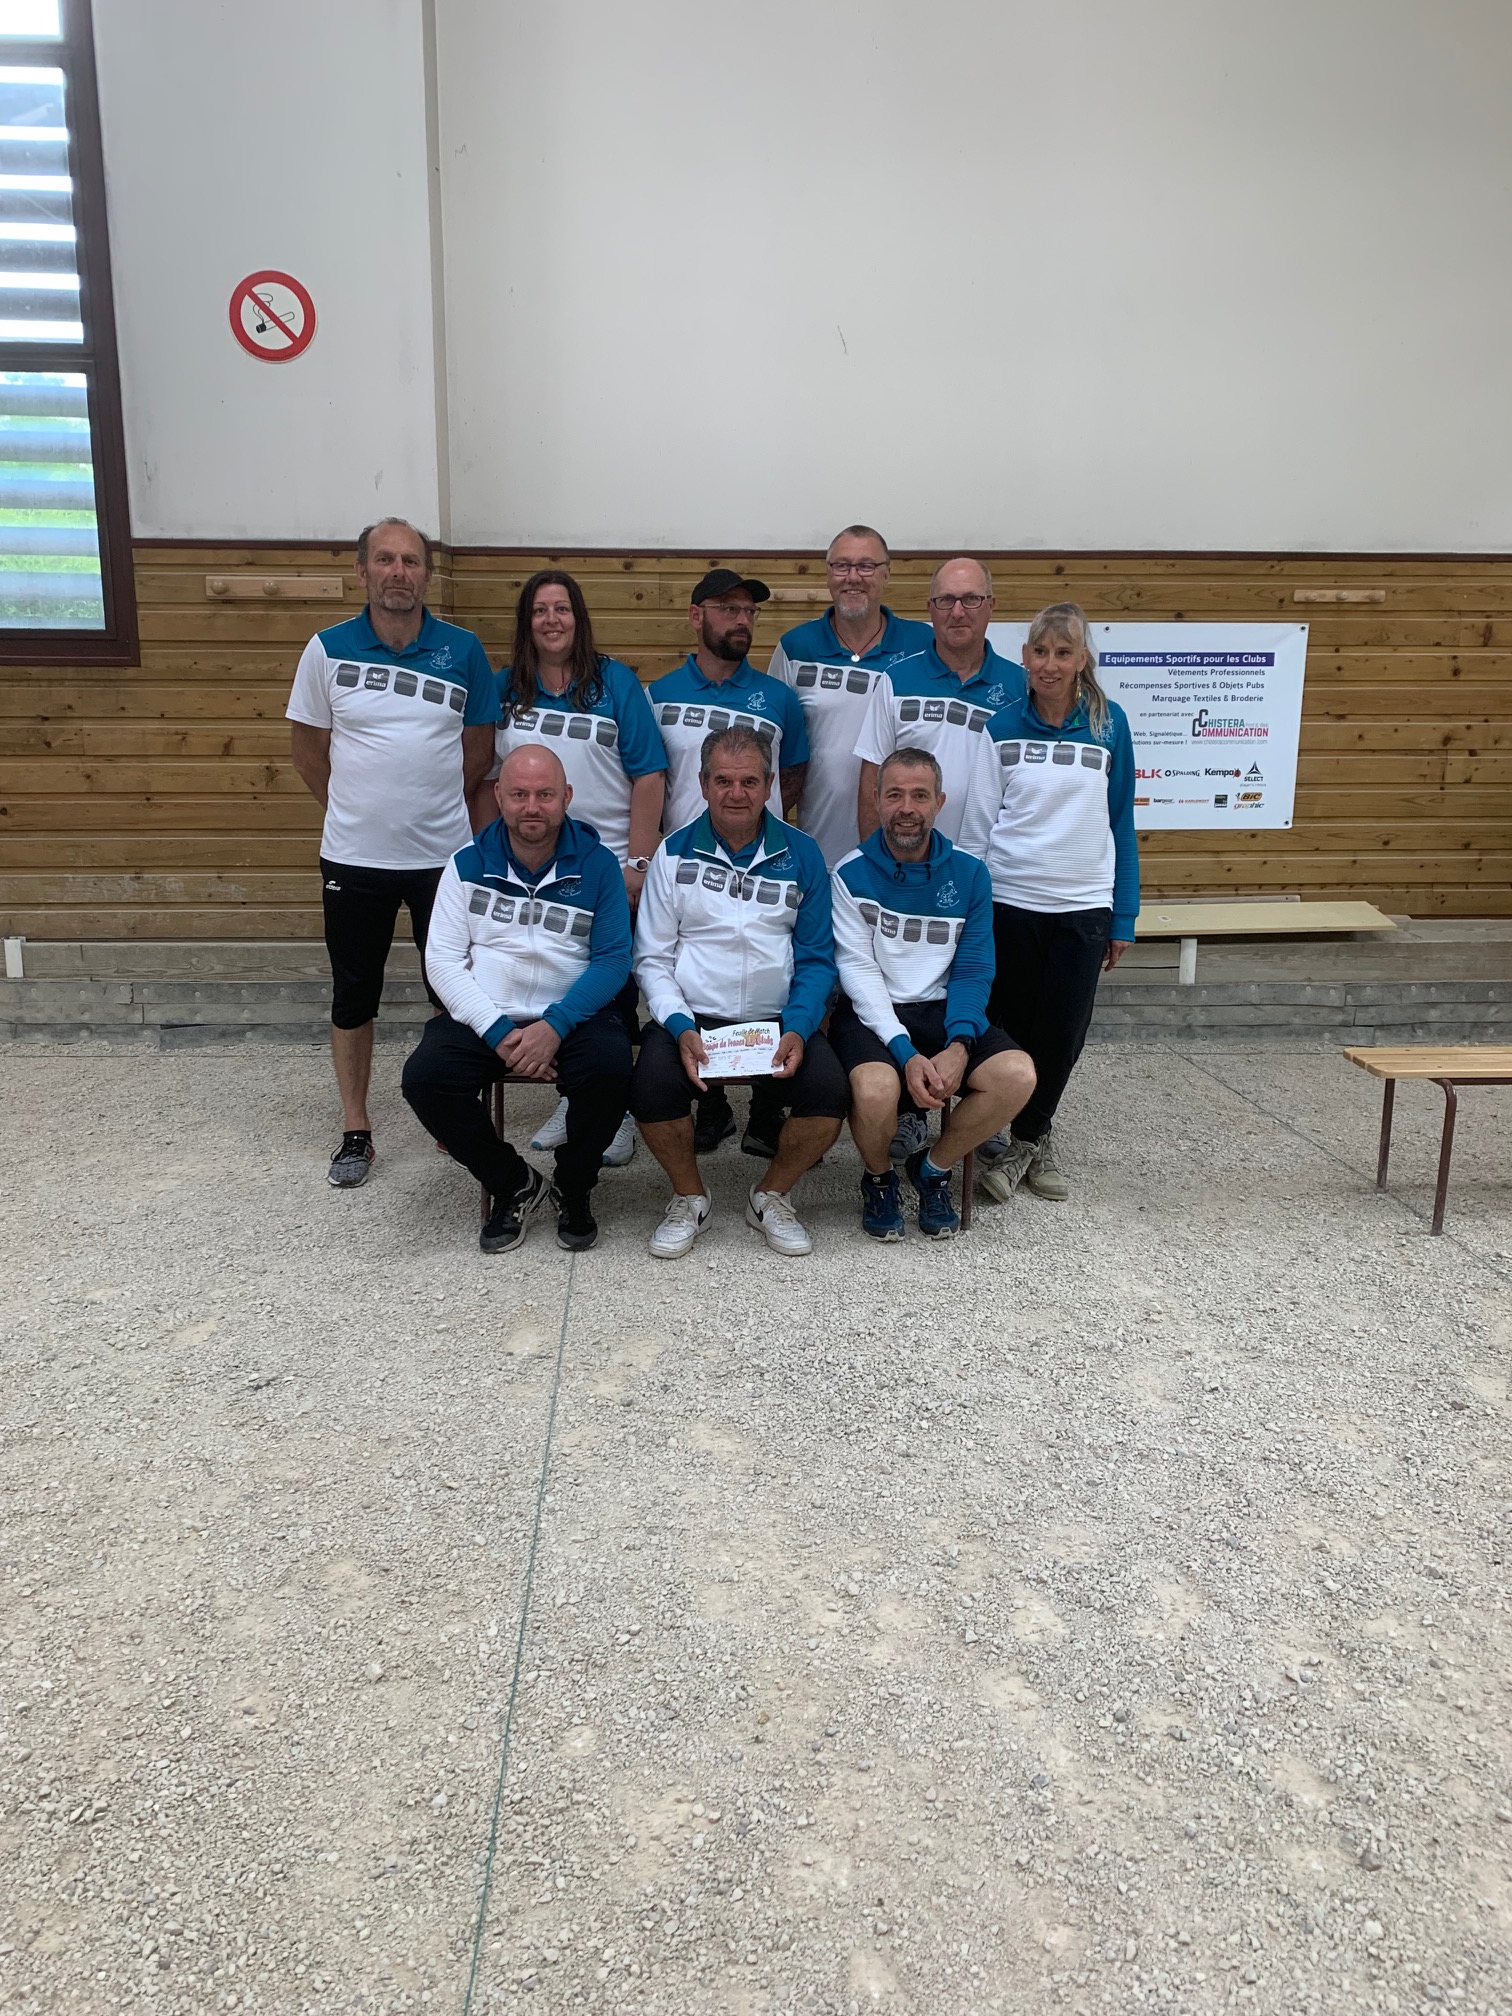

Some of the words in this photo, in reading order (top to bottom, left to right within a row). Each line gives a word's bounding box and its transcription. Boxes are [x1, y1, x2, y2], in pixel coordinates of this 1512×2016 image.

[1105, 654, 1163, 664] Equipements
[1166, 654, 1201, 664] Sportifs
[1204, 656, 1224, 664] pour
[1226, 654, 1240, 662] les
[1242, 654, 1266, 662] Clubs
[366, 680, 386, 688] erima
[1120, 682, 1172, 690] Récompenses
[1174, 682, 1210, 690] Sportives
[1219, 682, 1244, 690] Objets
[1152, 694, 1191, 703] Marquage
[1198, 709, 1245, 728] CHISTERA
[1192, 718, 1268, 737] COMMUNICATION
[1135, 769, 1162, 778] BLK
[704, 880, 723, 888] erima
[493, 910, 512, 919] erima
